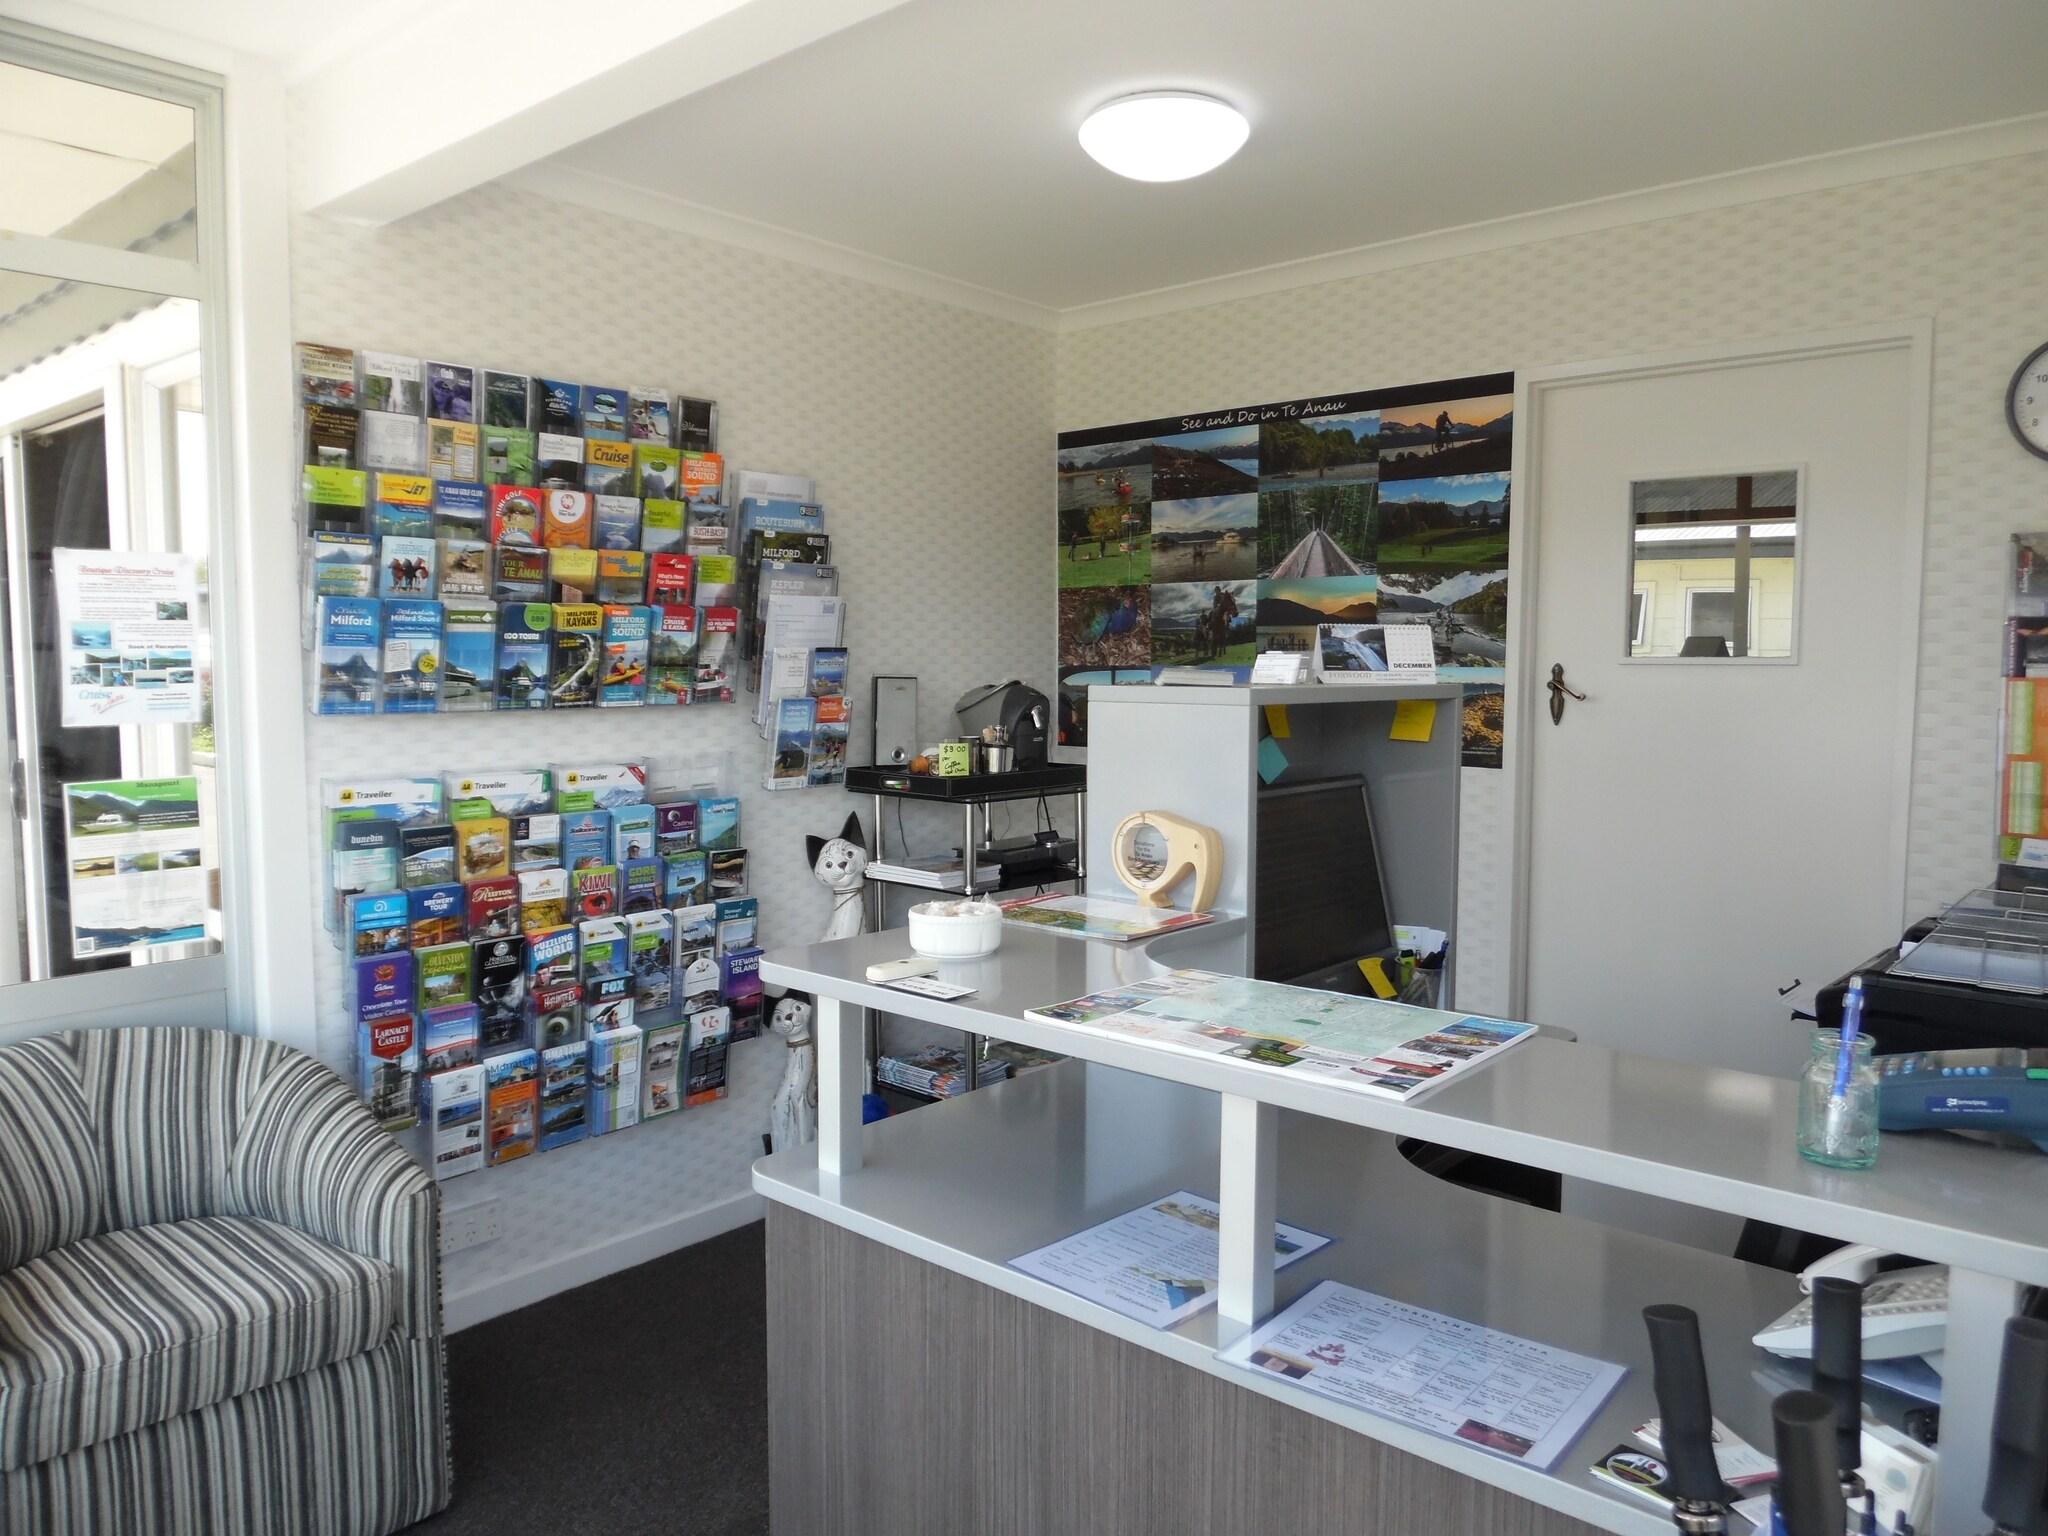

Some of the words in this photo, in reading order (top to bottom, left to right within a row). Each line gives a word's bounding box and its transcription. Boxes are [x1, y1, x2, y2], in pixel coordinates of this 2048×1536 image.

[2036, 374, 2048, 383] 10
[2026, 396, 2034, 406] 9
[1181, 418, 1203, 431] See
[1206, 414, 1234, 427] and
[1238, 411, 1257, 422] Do
[1260, 408, 1279, 420] in
[1281, 404, 1300, 417] Te
[1302, 402, 1348, 416] Anau
[2032, 418, 2038, 427] 8
[594, 448, 629, 463] Cruise
[762, 548, 800, 558] MILFORD
[504, 567, 516, 577] TE
[518, 569, 544, 579] ANAU
[330, 615, 372, 626] Milford
[566, 616, 598, 628] KAYAKS
[612, 628, 645, 638] SOUND
[579, 772, 608, 782] Traveller
[474, 781, 506, 790] Traveller
[356, 790, 392, 800] Traveller
[578, 872, 612, 892] KIWI
[534, 932, 573, 950] PUZZLING
[535, 942, 573, 961] WORLD
[730, 958, 759, 968] STEWAR
[732, 964, 759, 974] ISLAND
[601, 979, 625, 994] FOX
[374, 1025, 409, 1039] LARNACH
[378, 1035, 406, 1048] CASTLE
